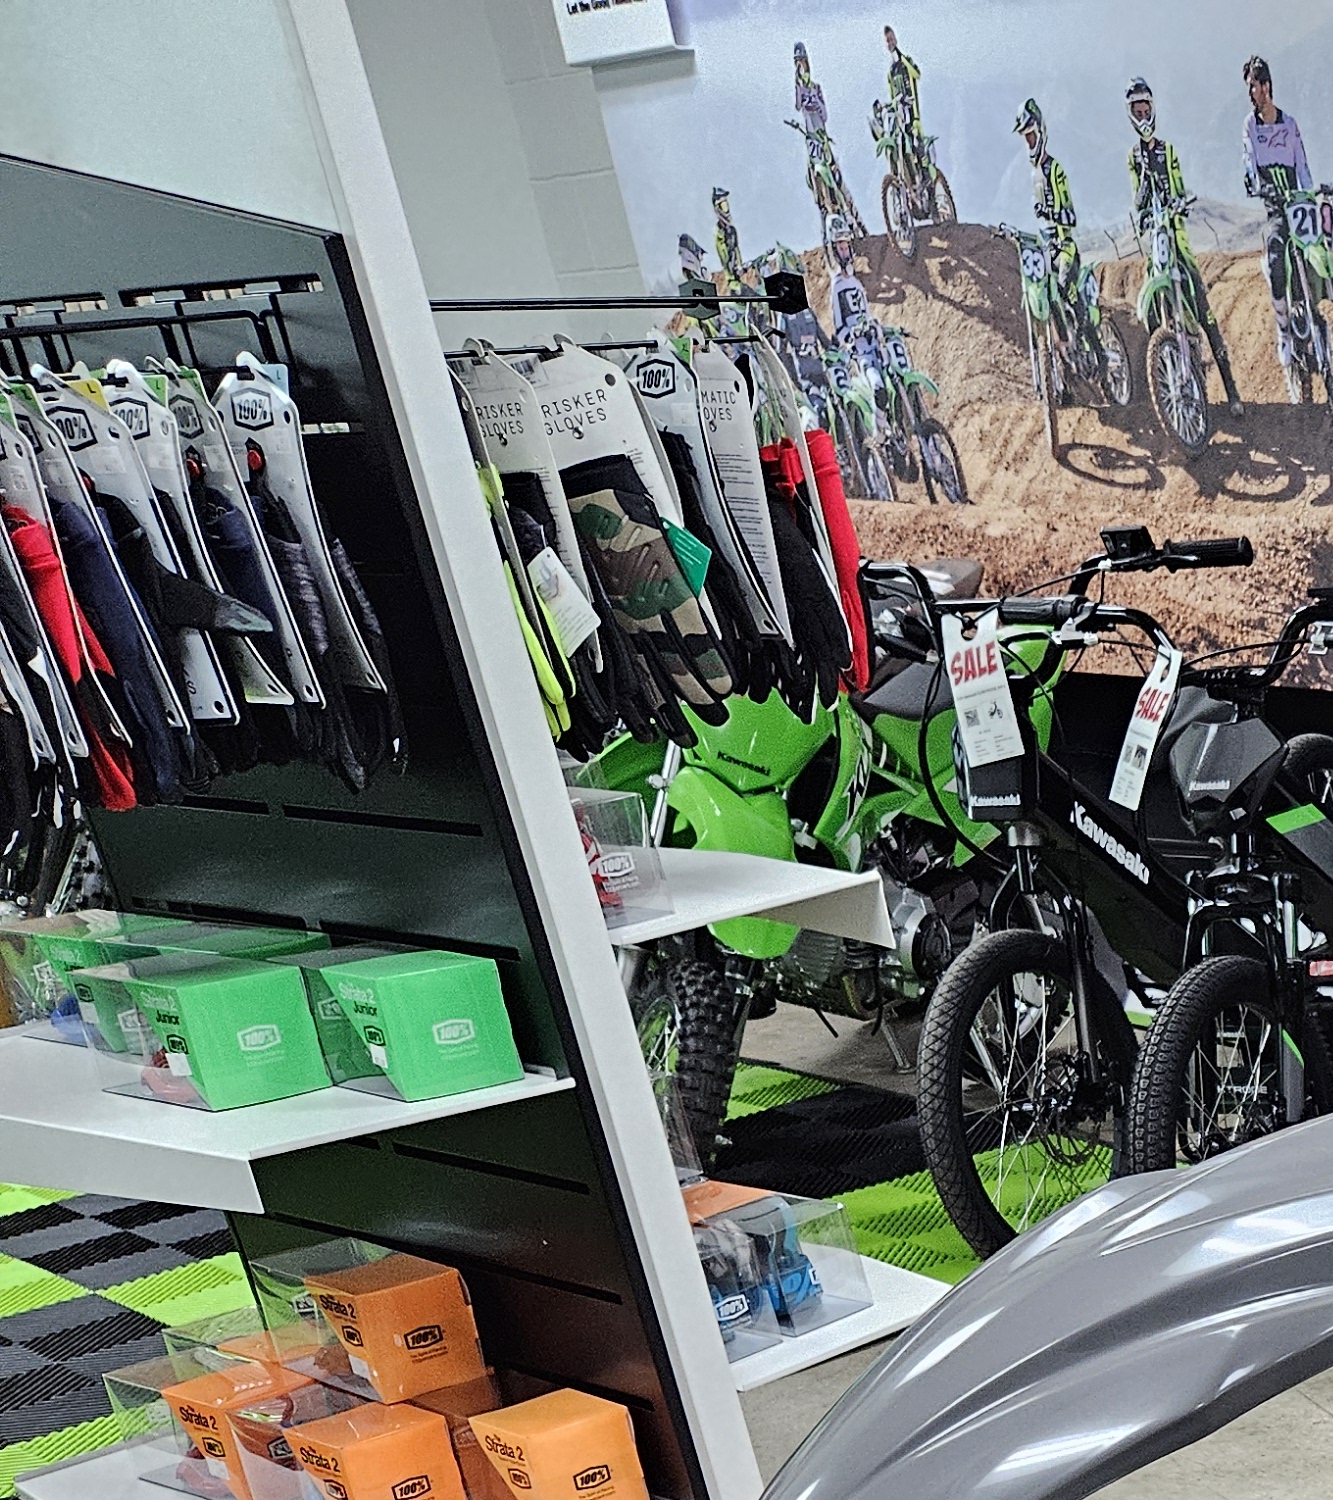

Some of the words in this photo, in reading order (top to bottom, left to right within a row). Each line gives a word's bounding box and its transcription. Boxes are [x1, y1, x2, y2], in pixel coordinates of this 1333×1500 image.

[1292, 207, 1318, 237] 21
[642, 368, 671, 388] 100%
[541, 388, 608, 419] RISKER
[701, 390, 737, 406] MATIC
[114, 409, 144, 430] 00%
[236, 400, 267, 421] 100%
[476, 402, 523, 420] RISKER
[703, 408, 733, 423] OVES
[951, 640, 998, 687] SALE
[1135, 687, 1171, 722] SALE
[717, 751, 771, 777] Kawasaki
[1070, 801, 1149, 885] Kawasaki
[243, 1030, 275, 1045] 100%
[440, 1023, 471, 1041] 100%
[719, 1299, 744, 1317] 100%
[410, 1330, 438, 1346] 100%
[179, 1406, 208, 1428] Strata
[208, 1415, 219, 1431] 2
[485, 1435, 515, 1459] Strata
[516, 1446, 525, 1462] 2
[300, 1447, 332, 1470] Strata
[331, 1457, 341, 1473] 2
[579, 1469, 606, 1486] 100%
[398, 1480, 425, 1498] 100%
